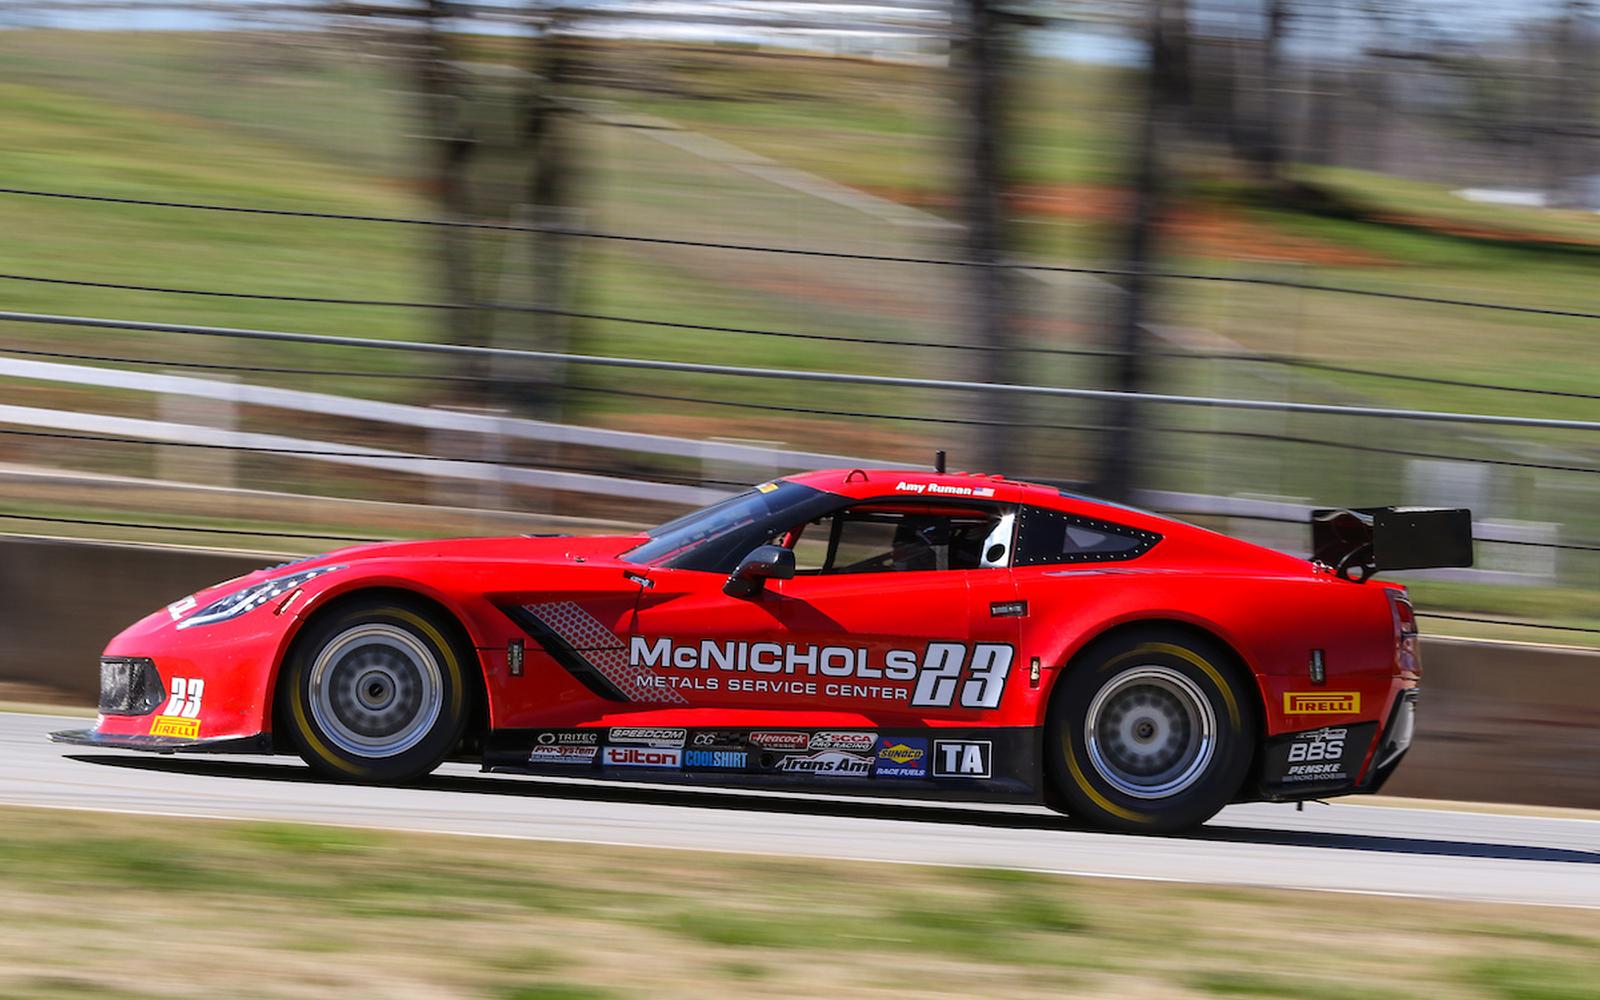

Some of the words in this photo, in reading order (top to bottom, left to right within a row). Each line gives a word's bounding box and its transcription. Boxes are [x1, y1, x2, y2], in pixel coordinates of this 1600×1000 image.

[896, 481, 926, 495] Amy
[928, 483, 972, 495] Ruman
[630, 637, 918, 681] McNICHOLS
[908, 641, 1015, 709] 23
[636, 675, 719, 691] METALS
[728, 679, 817, 695] SERVICE
[825, 684, 908, 700] CENTER
[163, 677, 204, 719] 23
[1290, 695, 1353, 711] PIRELLI
[152, 719, 197, 737] PIRELLI
[611, 729, 684, 739] SPEEDCOM
[558, 733, 598, 741] TRITEC
[756, 733, 805, 744] Heacock
[831, 734, 872, 743] SCCA
[833, 742, 870, 750] RACING
[881, 749, 922, 758] SUNOCO
[1288, 740, 1345, 762] BBS
[608, 748, 677, 765] tilton
[686, 750, 748, 768] COOLSHIRT
[780, 755, 834, 772] Trans
[834, 758, 869, 773] Am
[942, 744, 984, 773] TA
[876, 767, 899, 775] RACE
[900, 768, 925, 777] FUELS
[1288, 763, 1341, 775] PENSKE
